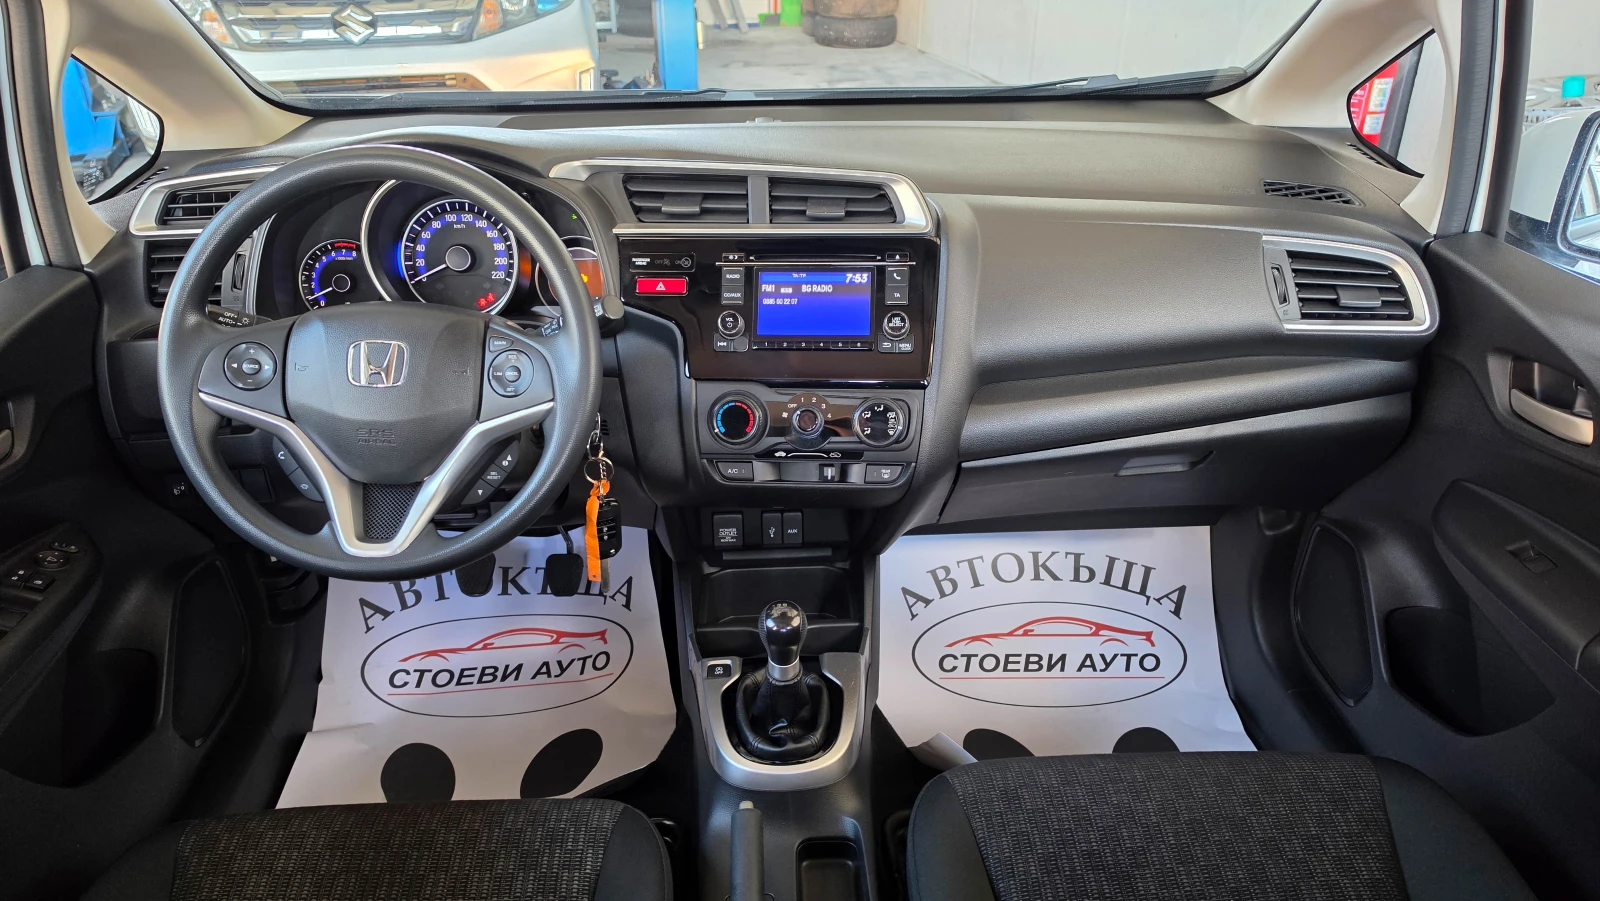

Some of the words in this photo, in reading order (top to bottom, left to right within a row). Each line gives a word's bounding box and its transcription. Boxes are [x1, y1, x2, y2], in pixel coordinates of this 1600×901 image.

[475, 220, 487, 228] 140
[421, 231, 431, 239] 60
[486, 230, 498, 238] 160
[416, 244, 426, 252] 40
[493, 243, 505, 251] 180
[494, 257, 508, 265] 200
[491, 271, 505, 279] 220
[845, 273, 868, 284] 7:53
[761, 284, 775, 292] FM1
[801, 284, 812, 292] BG
[812, 284, 833, 292] RADIO
[357, 428, 395, 438] SRS
[900, 551, 1188, 621] АВТОКЪЩА
[938, 653, 1068, 673] СТОЕВИ
[1076, 653, 1162, 673] АУТО
[388, 663, 525, 689] СТОЕВИ
[530, 650, 612, 681] АУТО
